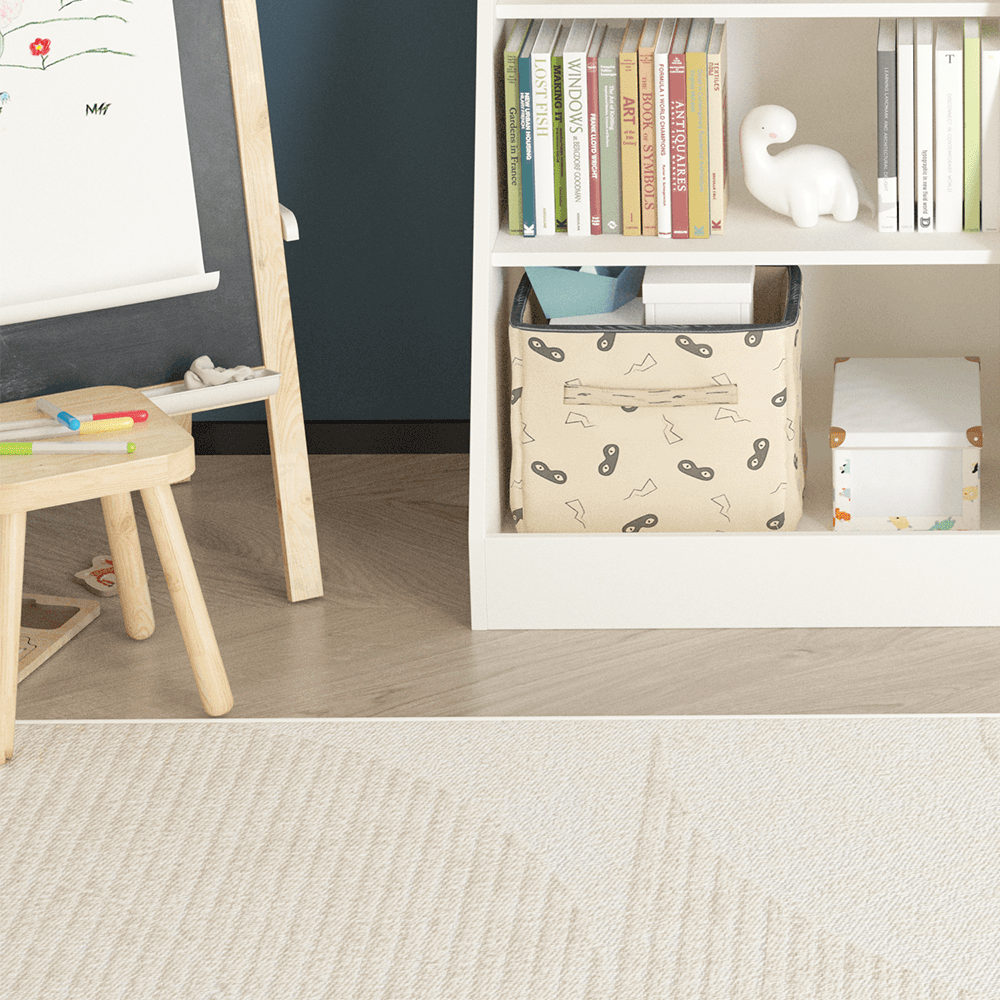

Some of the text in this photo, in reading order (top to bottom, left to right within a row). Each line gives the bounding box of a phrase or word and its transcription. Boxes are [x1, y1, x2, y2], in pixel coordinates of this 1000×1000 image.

[534, 59, 548, 137] LOST FISH
[553, 65, 562, 109] MAKING
[568, 58, 583, 133] WINDOWS
[623, 96, 636, 125] ART
[642, 93, 653, 130] BOOK
[554, 111, 562, 123] IT
[509, 107, 518, 186] Gardens in France
[674, 101, 686, 192] ANTIQUAIRES
[921, 150, 929, 175] typographic
[643, 145, 655, 210] SYMBOLS
